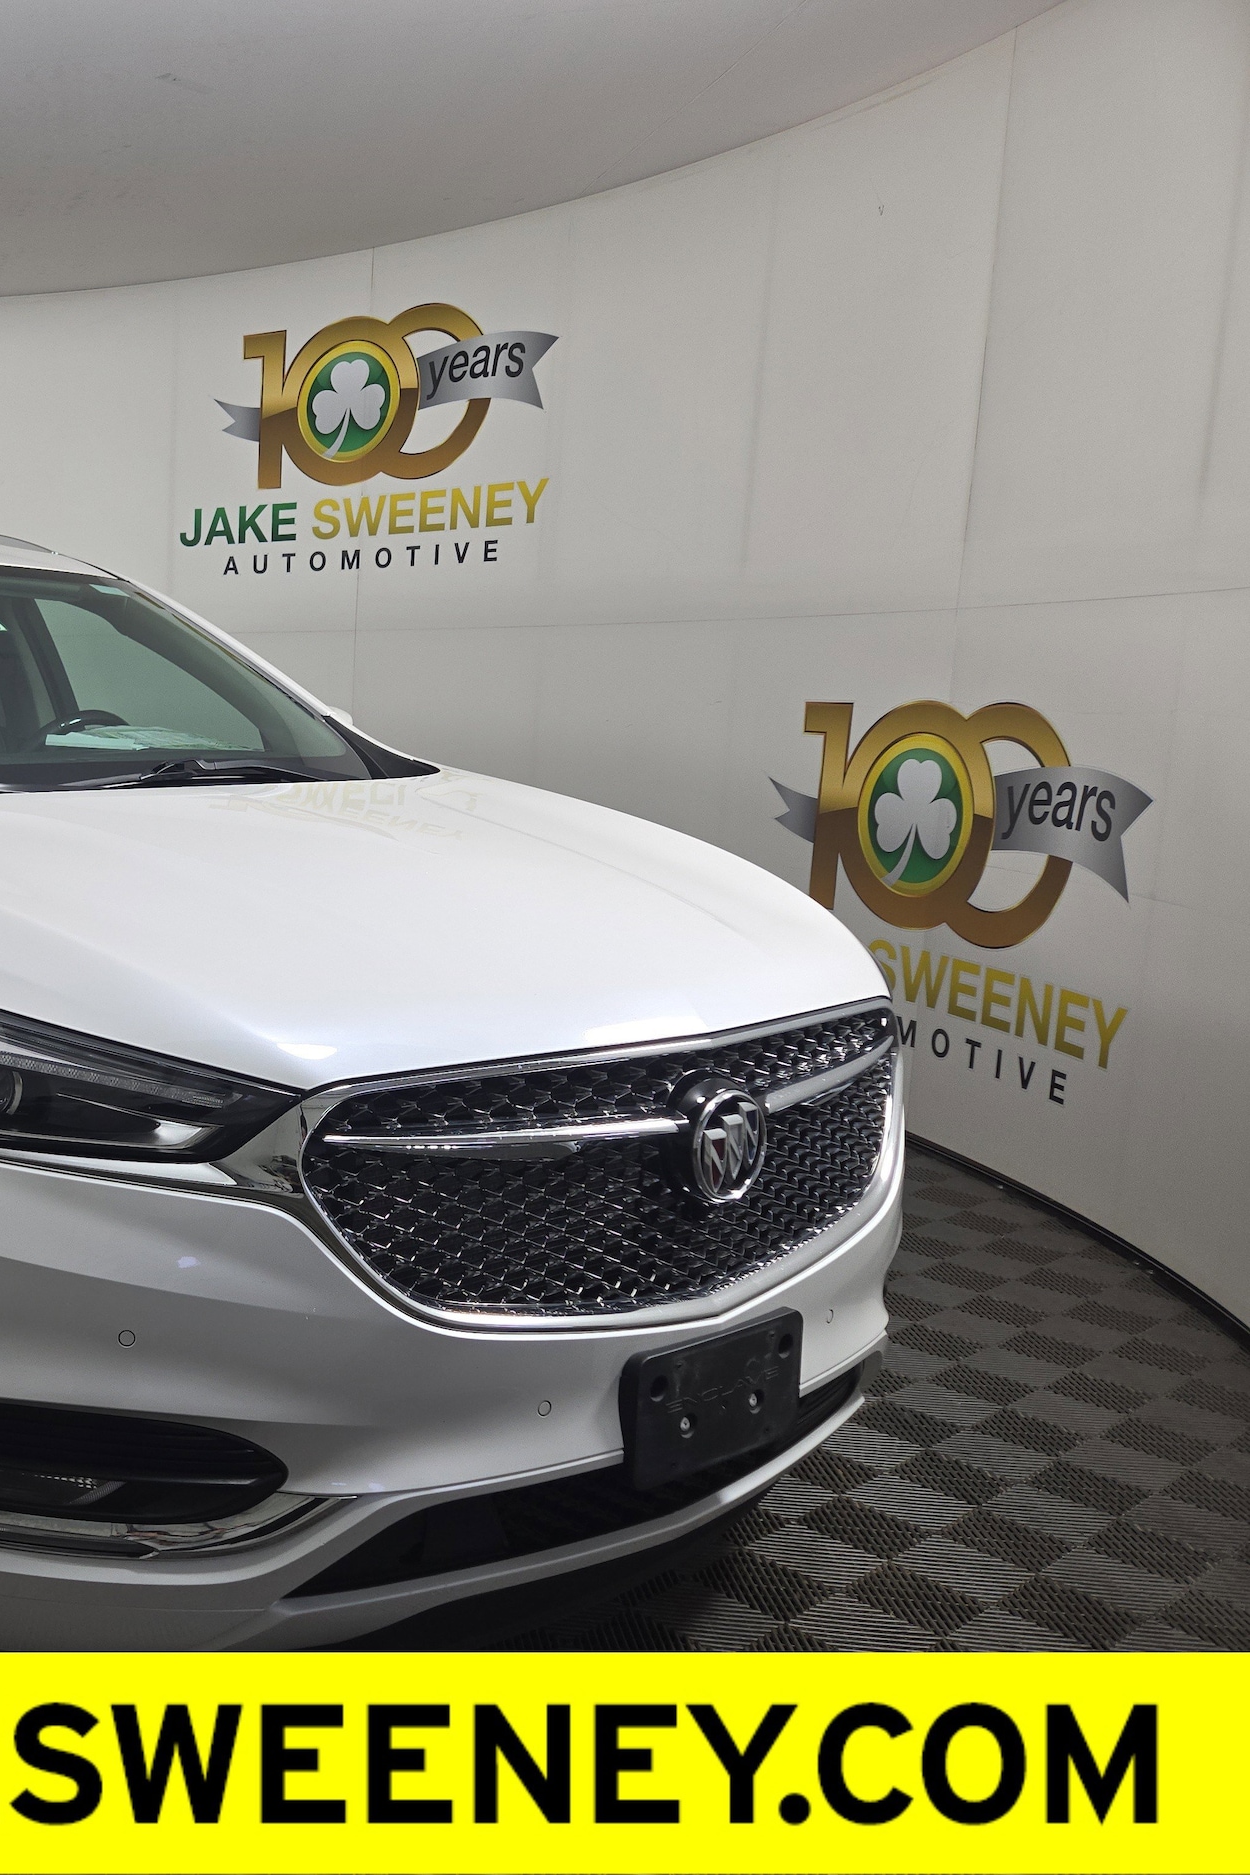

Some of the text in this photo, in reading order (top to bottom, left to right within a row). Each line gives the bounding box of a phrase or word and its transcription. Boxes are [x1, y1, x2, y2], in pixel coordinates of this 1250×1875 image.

[426, 341, 526, 400] years
[179, 477, 550, 548] JAKE SWEENEY
[223, 539, 500, 576] AUTOMOTIVE
[1000, 780, 1117, 843] years
[867, 938, 1129, 1070] SWEENEY
[896, 1014, 1068, 1106] MOTIVE
[665, 1366, 780, 1414] ENCLAVE
